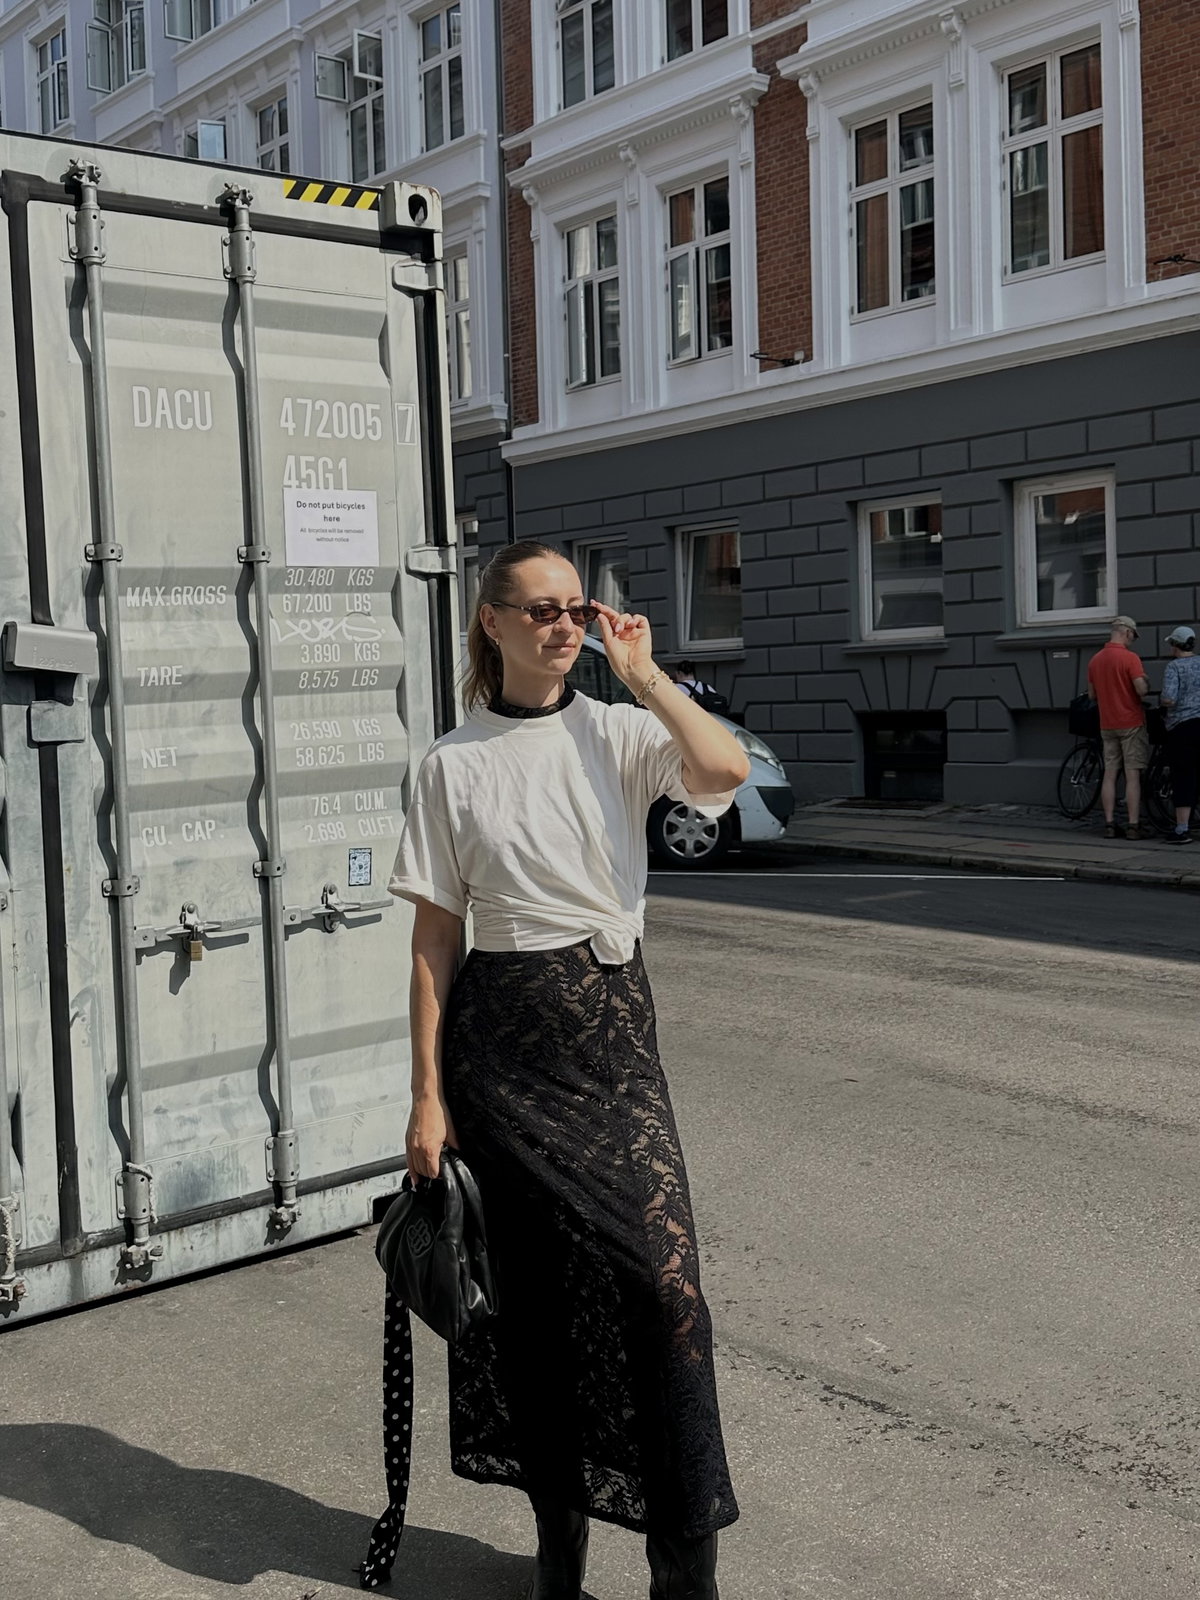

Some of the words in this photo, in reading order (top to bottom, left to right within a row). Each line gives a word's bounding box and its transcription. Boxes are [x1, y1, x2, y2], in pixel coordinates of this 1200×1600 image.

[132, 385, 213, 431] DACU
[279, 397, 382, 441] 472005
[397, 405, 412, 443] 7
[283, 455, 348, 490] 45G1
[296, 500, 307, 508] Do
[308, 501, 321, 509] not
[322, 501, 334, 510] put
[336, 501, 366, 511] bicycles
[323, 514, 341, 522] here
[347, 568, 375, 586] KGS
[126, 585, 227, 607] MAX.GROSS
[345, 593, 371, 612] LBS
[354, 642, 380, 662] KGS
[137, 665, 183, 687] TARE
[351, 668, 379, 687] LBS
[352, 718, 382, 737] KGS
[141, 746, 177, 769] NET
[358, 742, 385, 763] LBS
[312, 794, 341, 817] 76.4
[142, 825, 173, 848] CU.
